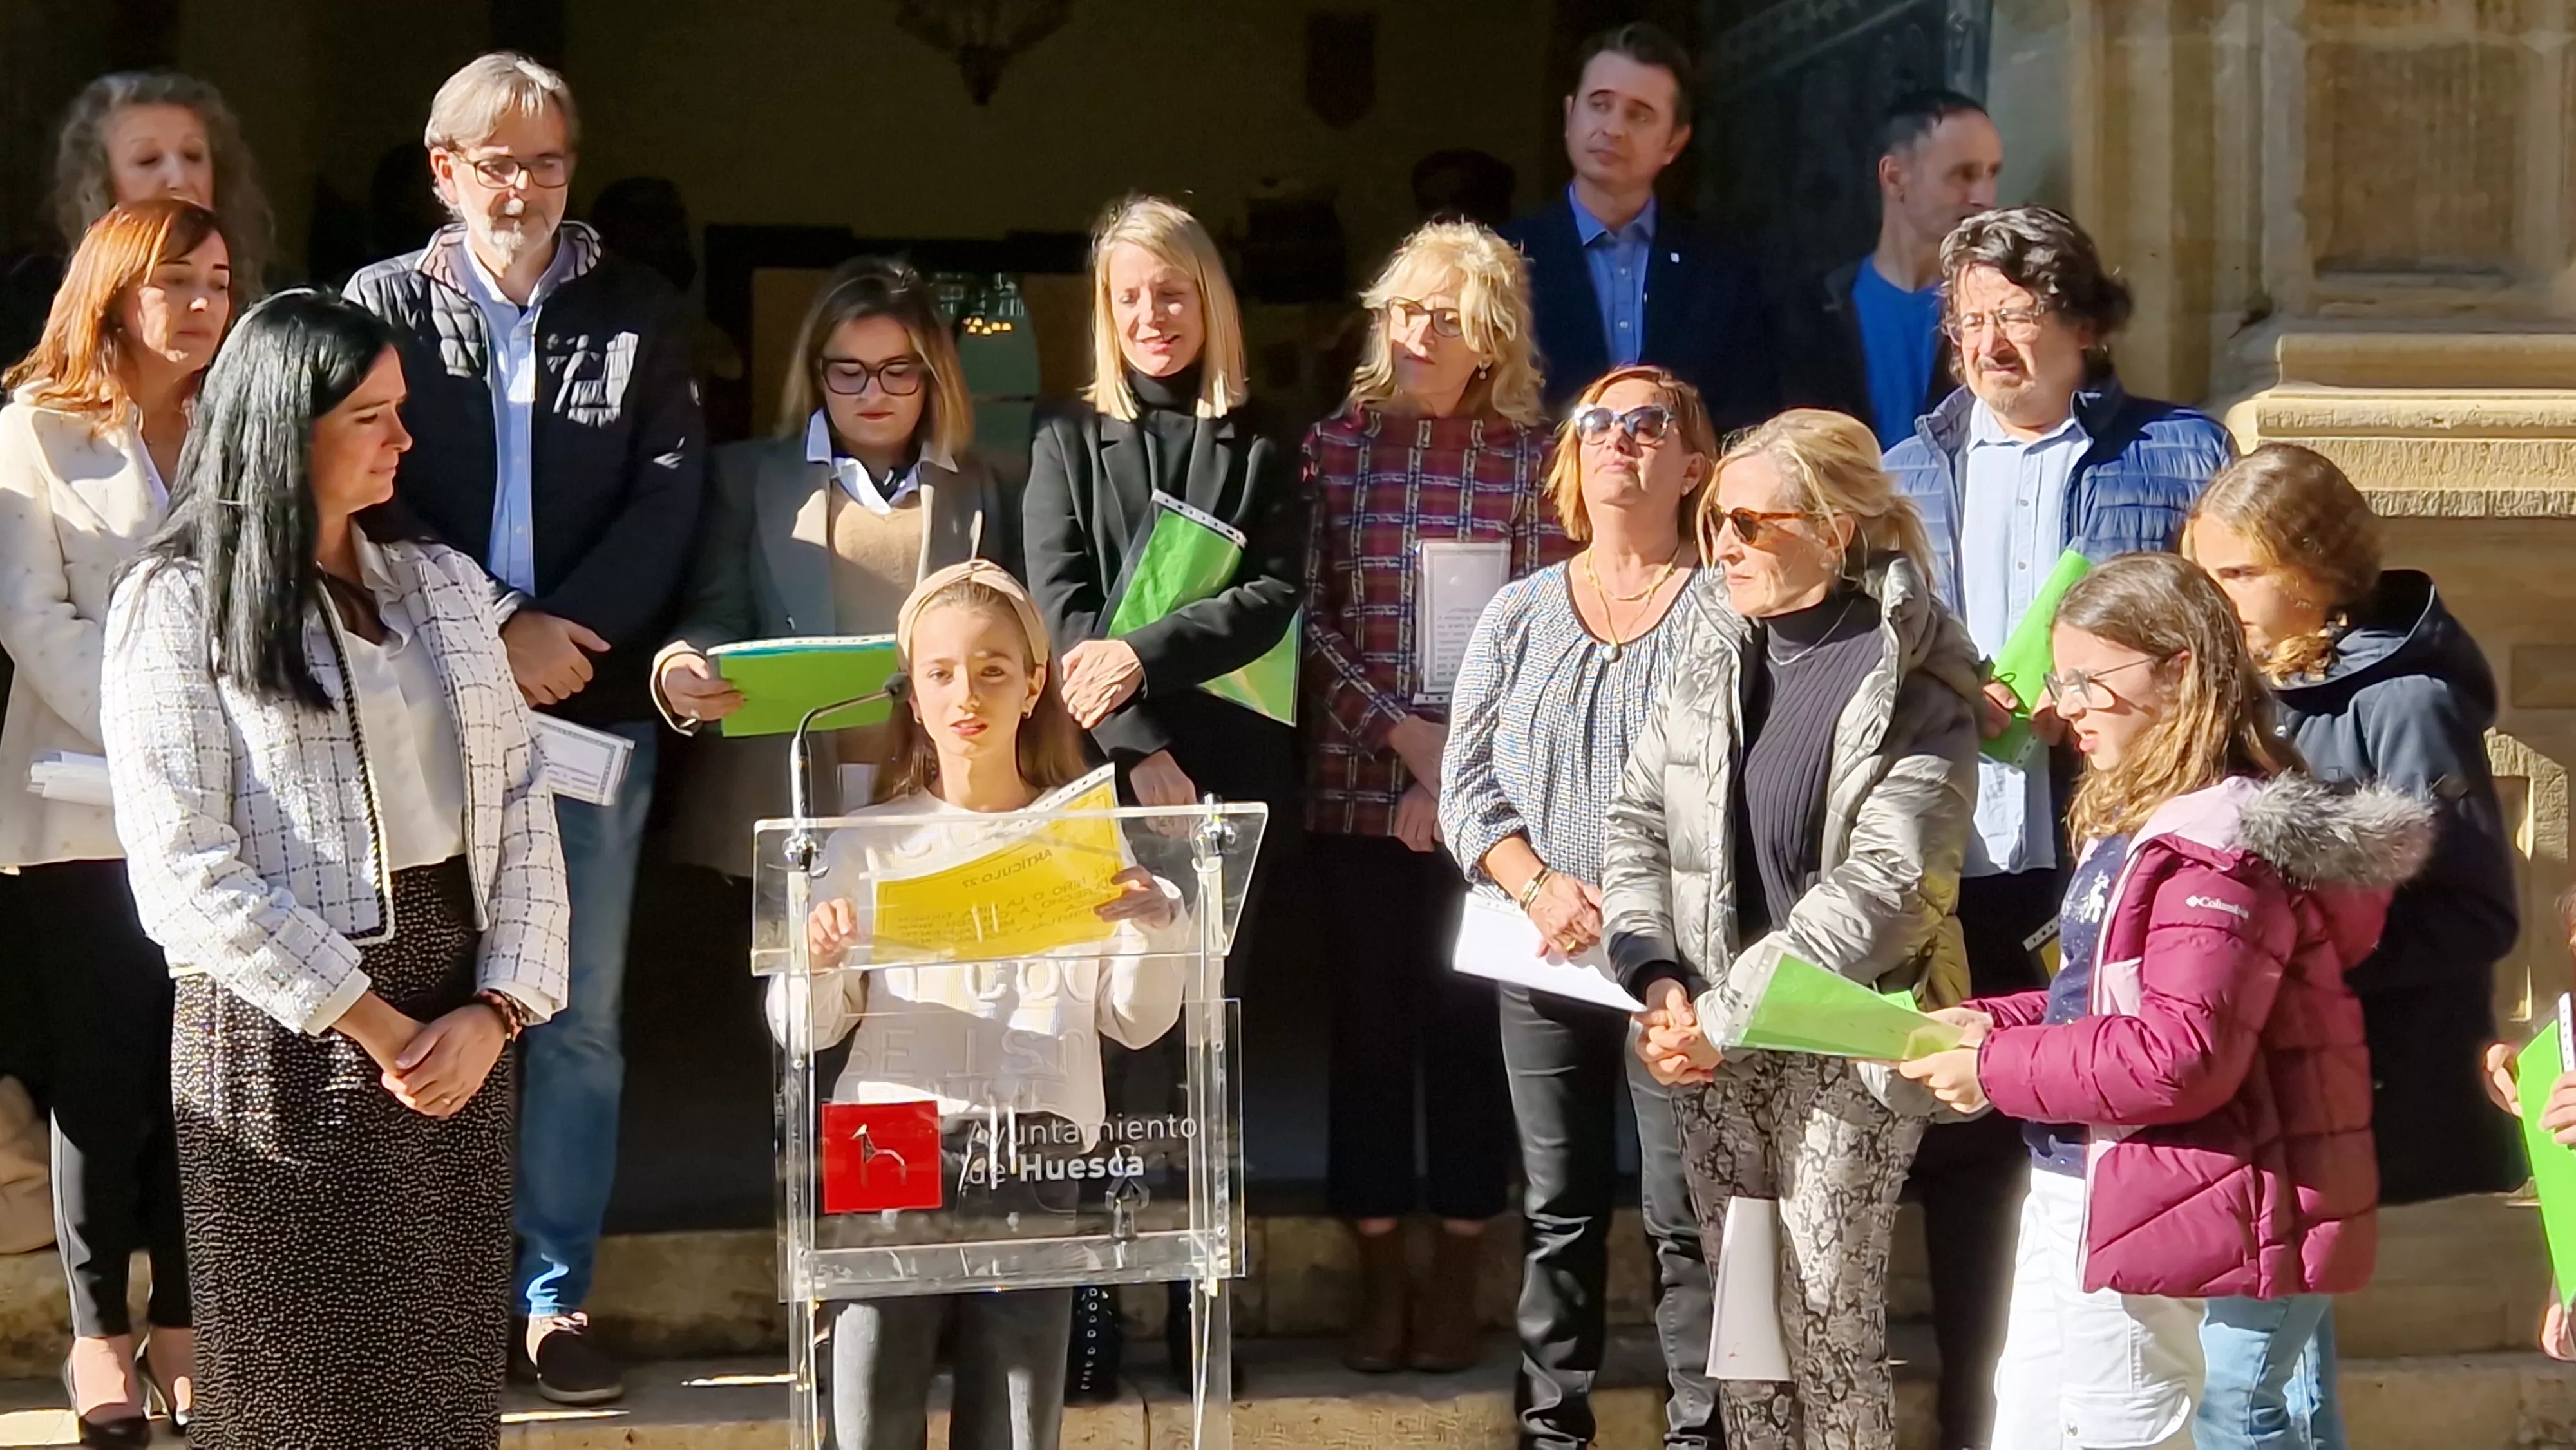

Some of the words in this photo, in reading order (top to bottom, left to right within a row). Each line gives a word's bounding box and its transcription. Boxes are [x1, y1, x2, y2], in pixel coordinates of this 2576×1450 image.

[968, 1112, 1199, 1148] Ayuntamiento
[968, 1156, 1007, 1184] de
[1019, 1153, 1145, 1182] Huesca
